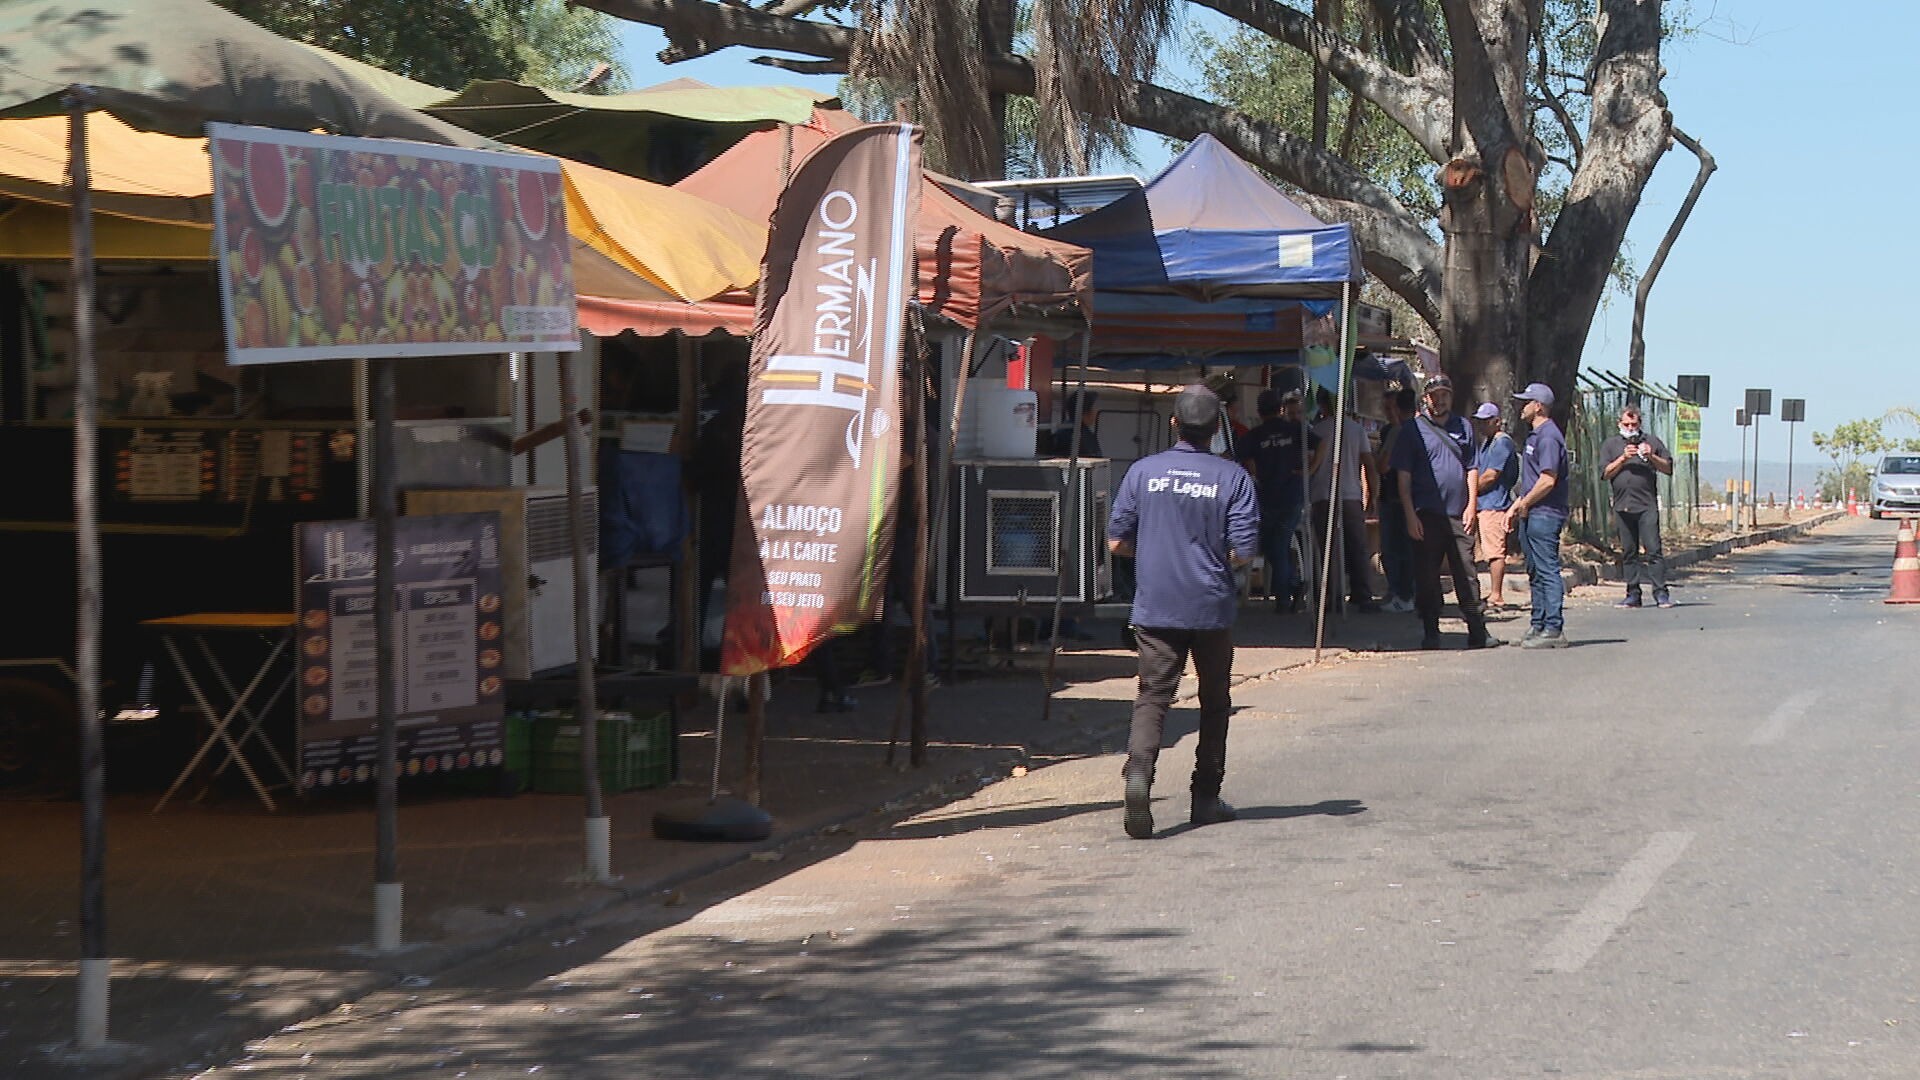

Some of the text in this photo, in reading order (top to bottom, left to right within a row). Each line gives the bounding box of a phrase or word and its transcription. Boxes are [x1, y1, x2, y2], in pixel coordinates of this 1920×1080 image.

[318, 181, 447, 267] FRUTAS
[761, 190, 869, 411] HERMANO
[1147, 478, 1218, 499] DF Legal
[761, 503, 843, 537] ALMOÇO
[760, 537, 839, 564] À LA CARTE
[767, 570, 823, 589] SEU PRATO
[775, 592, 798, 607] SEU
[798, 593, 826, 609] JEITO
